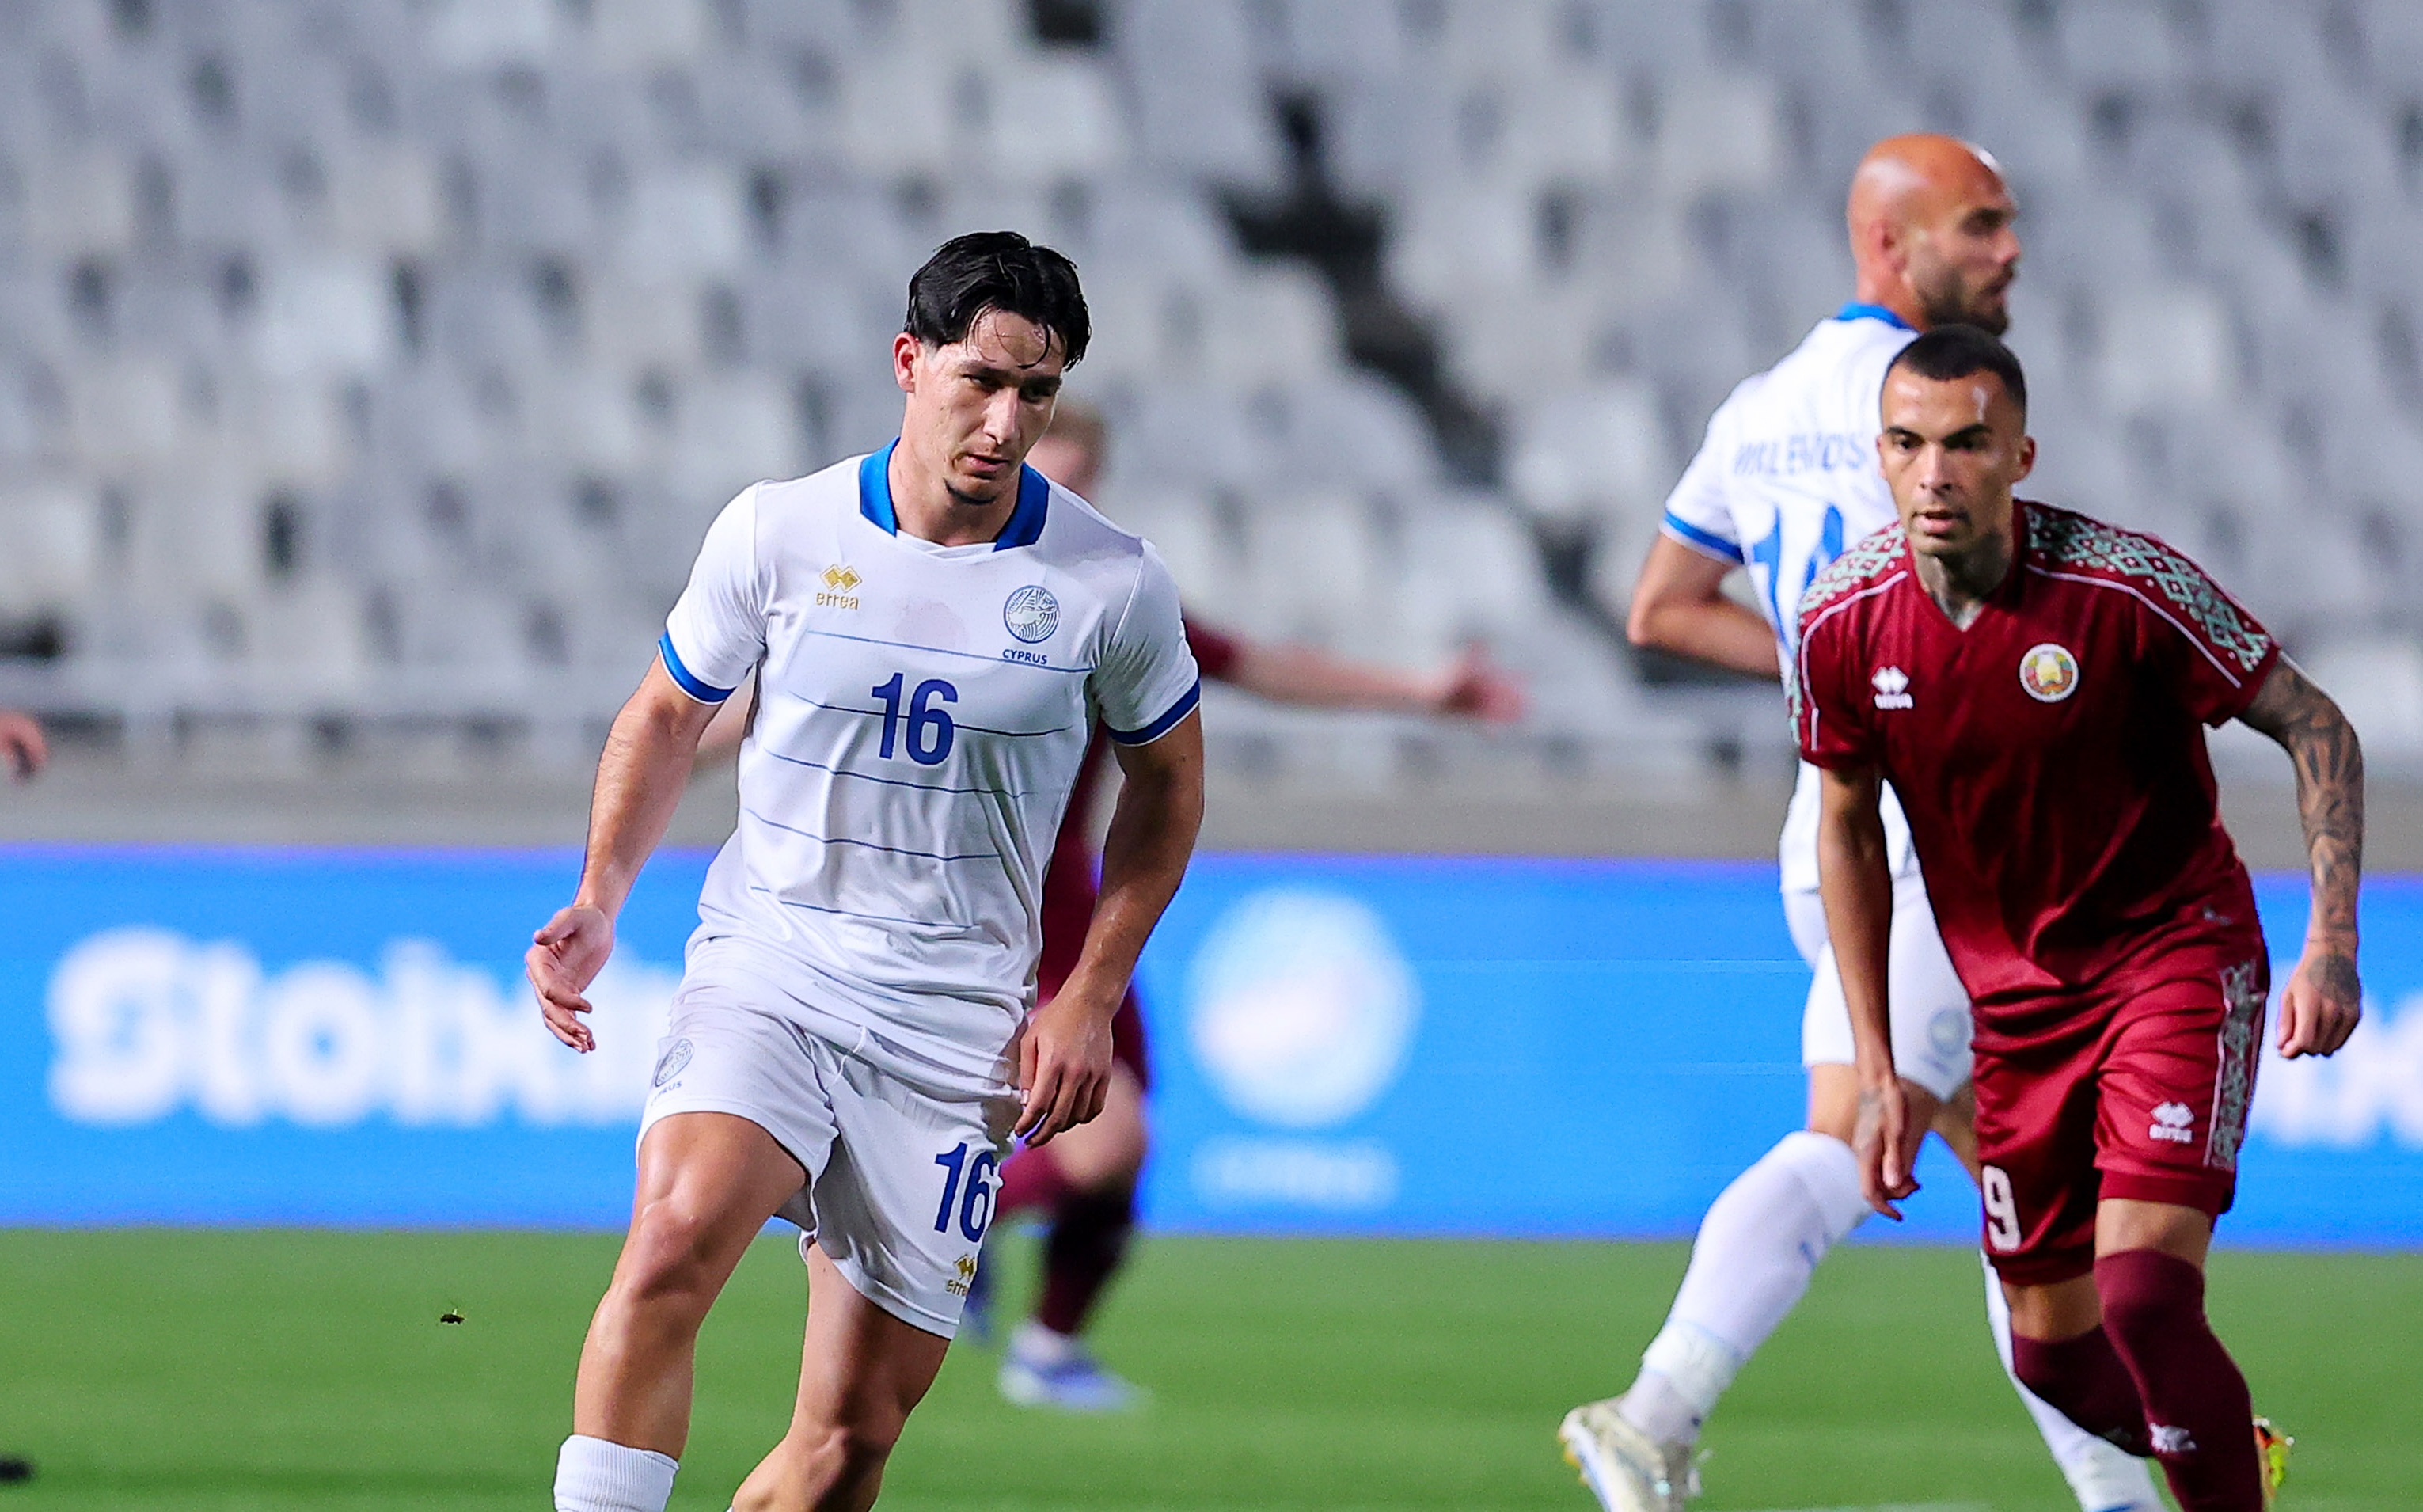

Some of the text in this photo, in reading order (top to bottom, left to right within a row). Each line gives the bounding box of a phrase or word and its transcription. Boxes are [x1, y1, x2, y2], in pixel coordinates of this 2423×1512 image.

[1002, 648, 1048, 665] CYPRUS
[872, 672, 959, 765] 16
[934, 1142, 994, 1243] 16
[1982, 1164, 2022, 1252] 9
